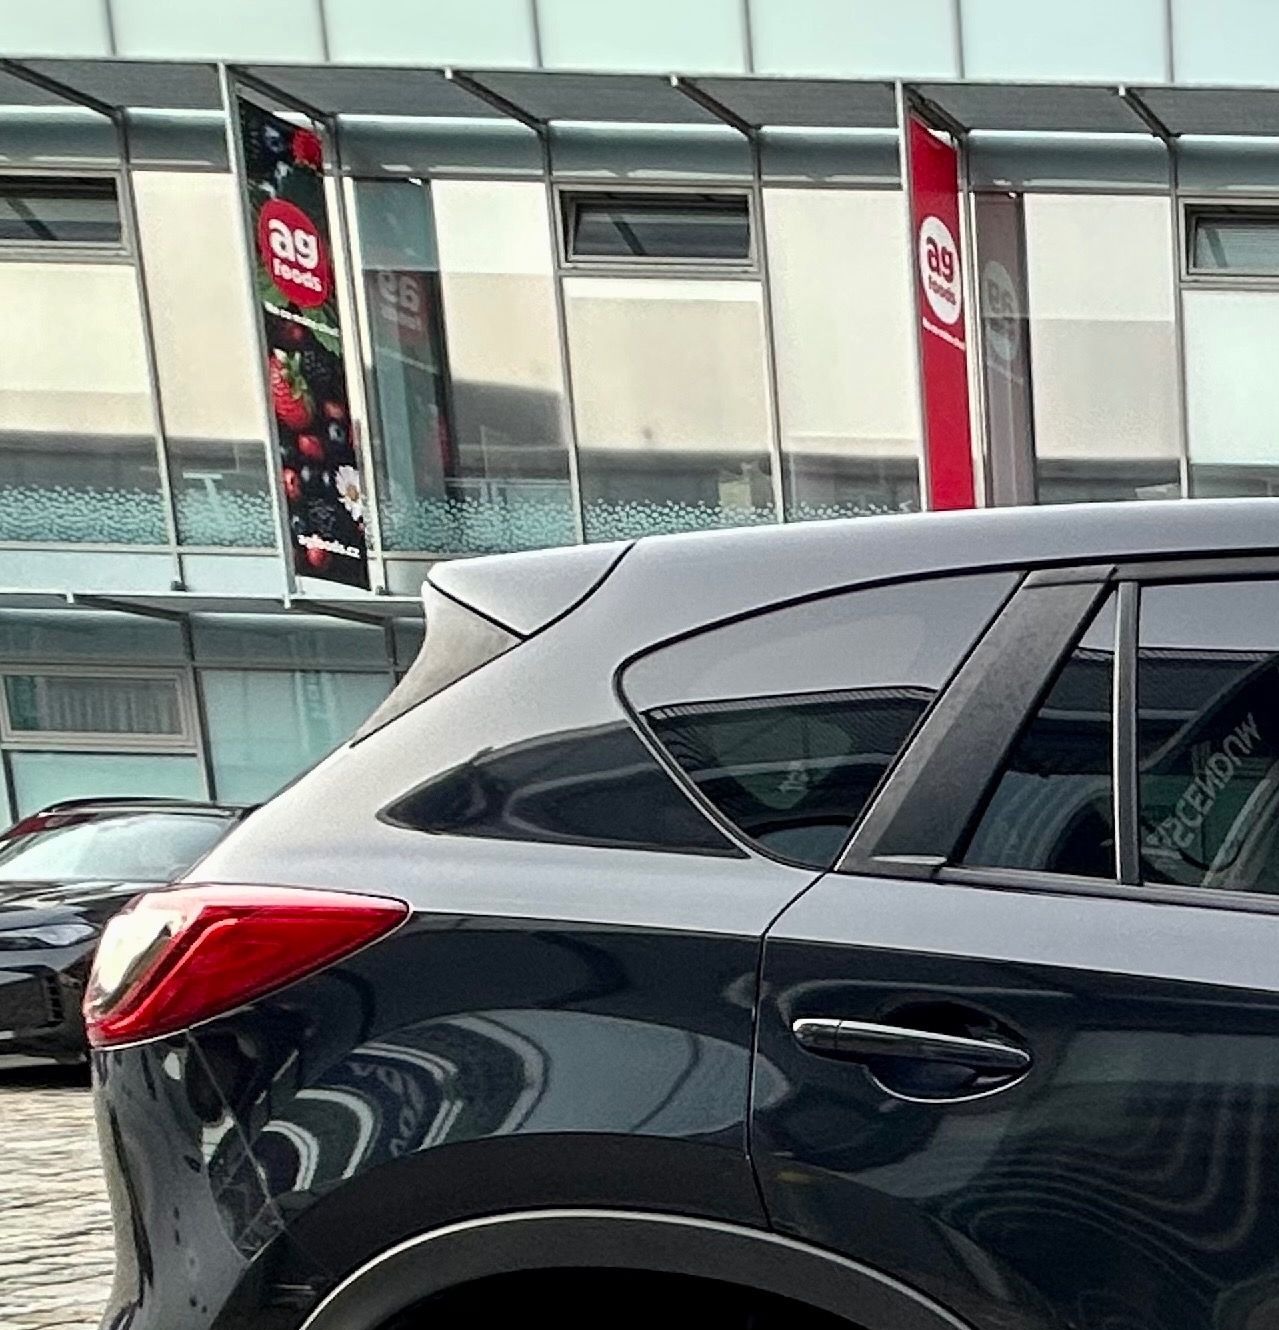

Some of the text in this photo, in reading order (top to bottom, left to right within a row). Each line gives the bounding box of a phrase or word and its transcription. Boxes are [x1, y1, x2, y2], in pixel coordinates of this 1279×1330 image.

[268, 218, 319, 270] ag
[926, 235, 953, 284] ag
[272, 257, 322, 292] foods
